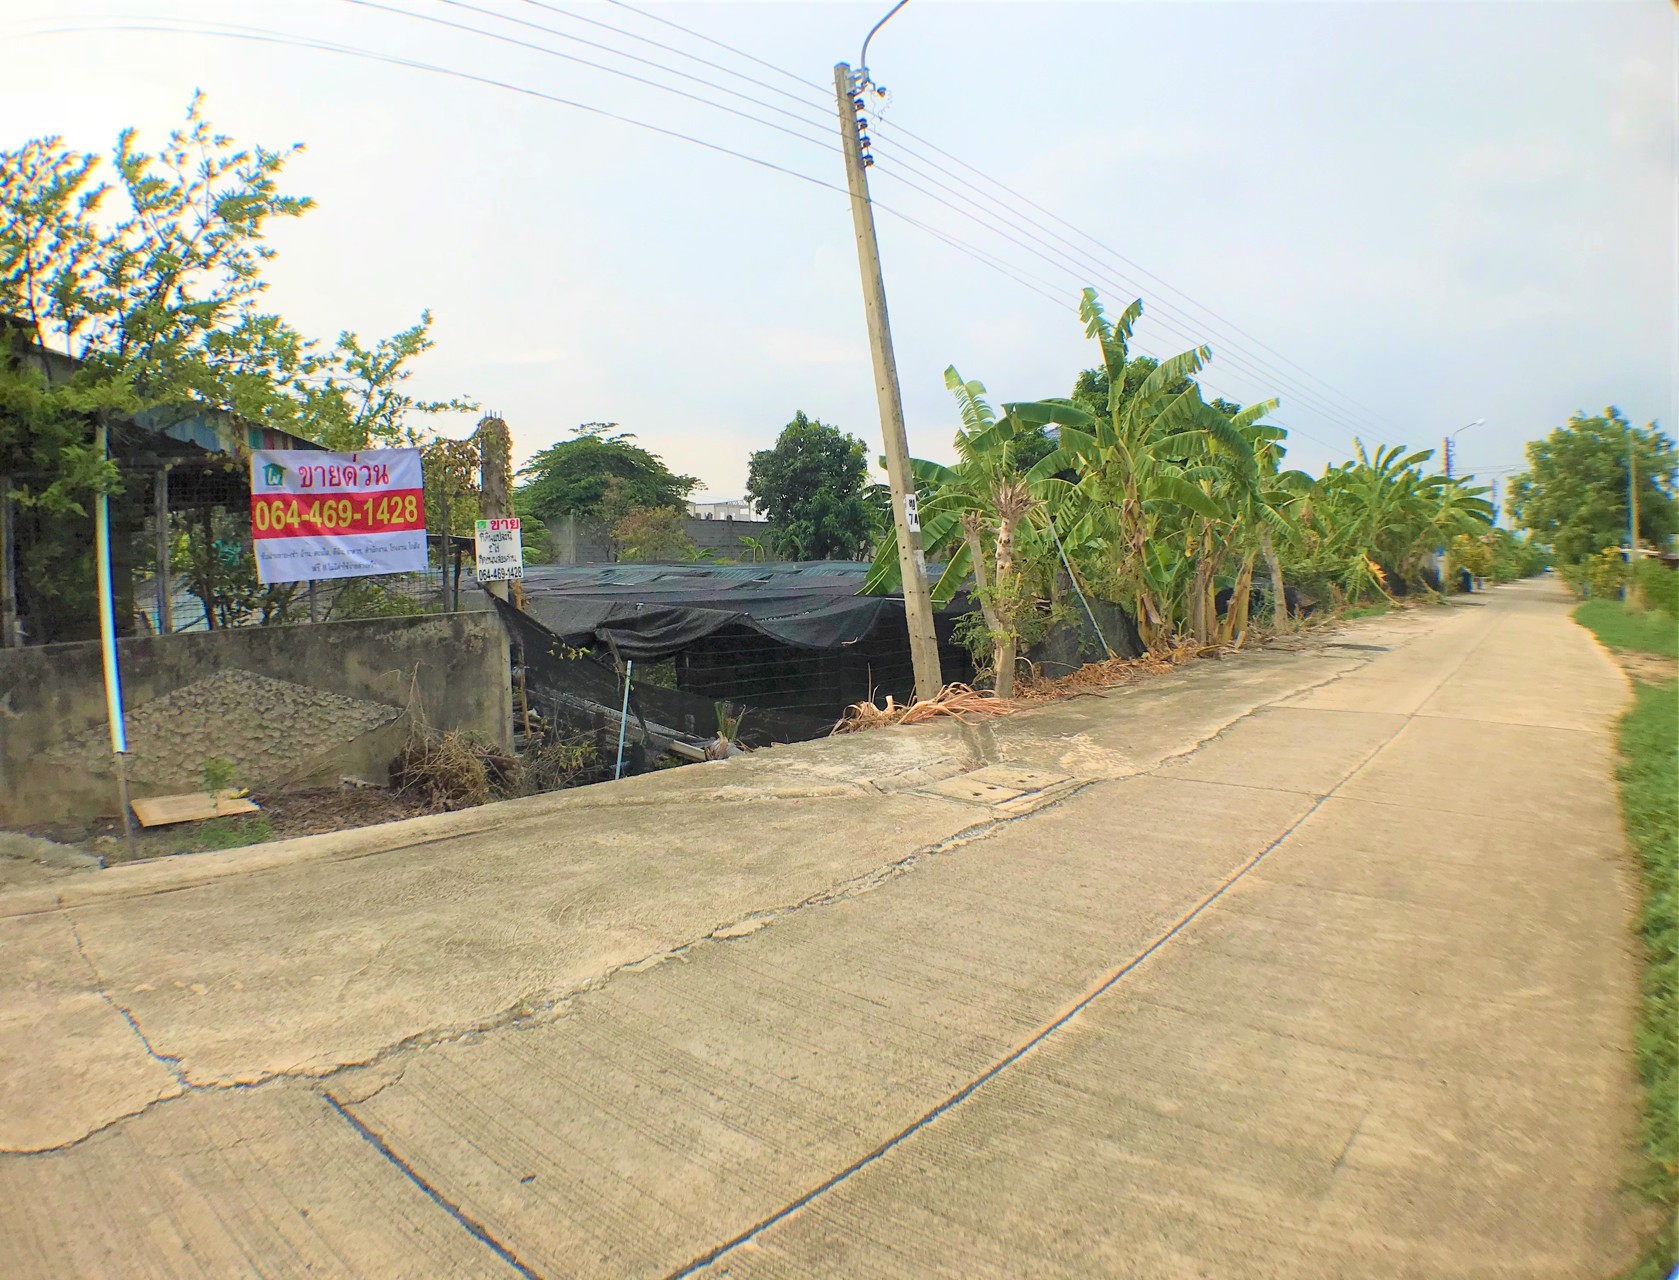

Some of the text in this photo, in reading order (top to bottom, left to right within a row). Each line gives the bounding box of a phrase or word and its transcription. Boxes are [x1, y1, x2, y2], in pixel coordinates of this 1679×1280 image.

[298, 453, 390, 489] ขายด่วน
[255, 495, 418, 531] 064-469-1428
[490, 518, 520, 531] ขาย
[478, 566, 523, 581] 064-469-1428
